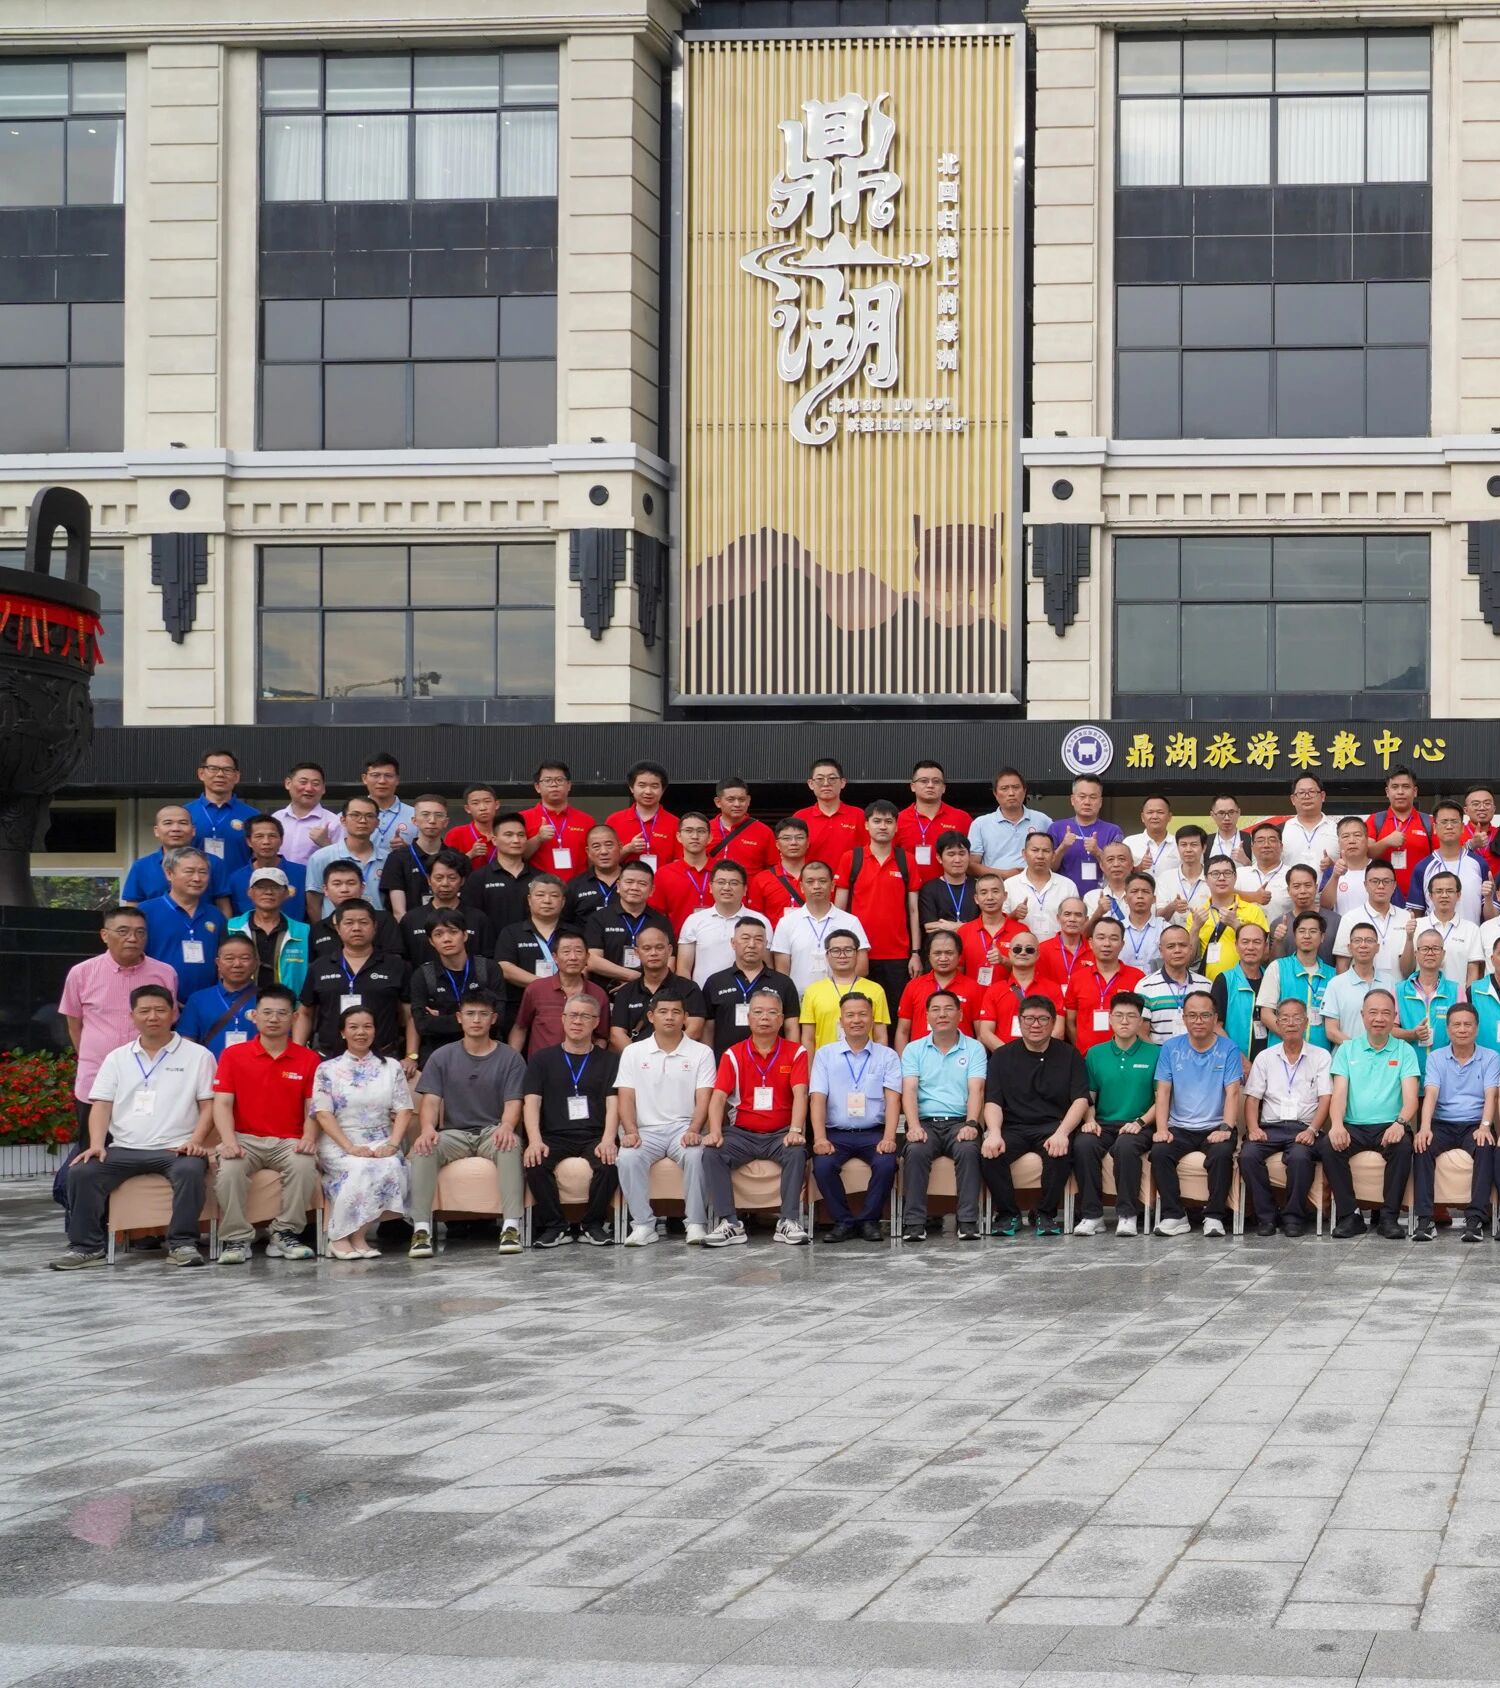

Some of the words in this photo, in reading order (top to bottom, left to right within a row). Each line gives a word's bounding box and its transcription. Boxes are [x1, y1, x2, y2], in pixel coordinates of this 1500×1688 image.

[1125, 729, 1447, 771] 鼎湖旅游集散中心
